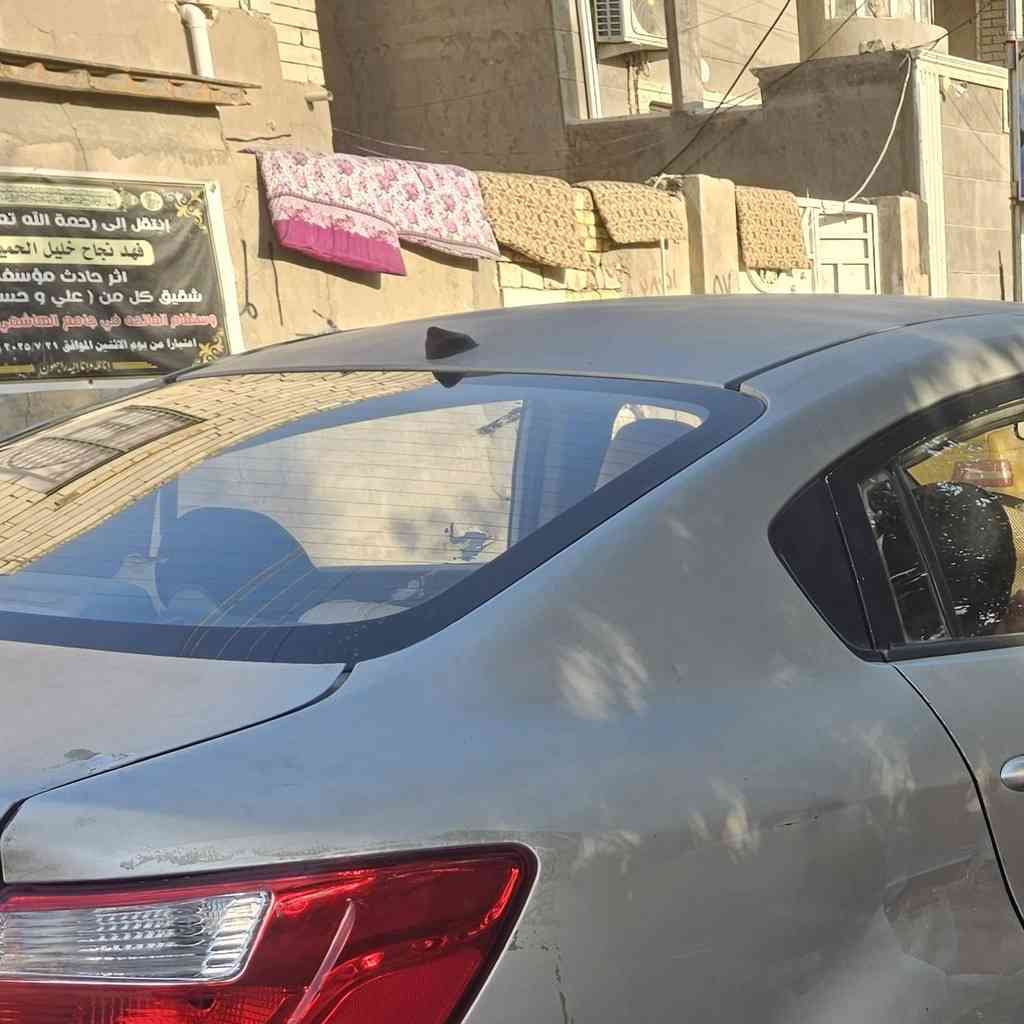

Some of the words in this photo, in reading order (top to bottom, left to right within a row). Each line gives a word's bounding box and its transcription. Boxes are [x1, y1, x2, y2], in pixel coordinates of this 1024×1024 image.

[22, 211, 49, 226] الله
[54, 213, 96, 231] رحمة
[0, 241, 38, 259] الحمي
[44, 240, 75, 260] خليل
[82, 240, 115, 261] نجاح
[121, 241, 145, 261] فهد
[60, 269, 103, 284] حادث
[99, 292, 124, 307] من
[130, 290, 154, 305] كل
[158, 288, 203, 306] شقيق
